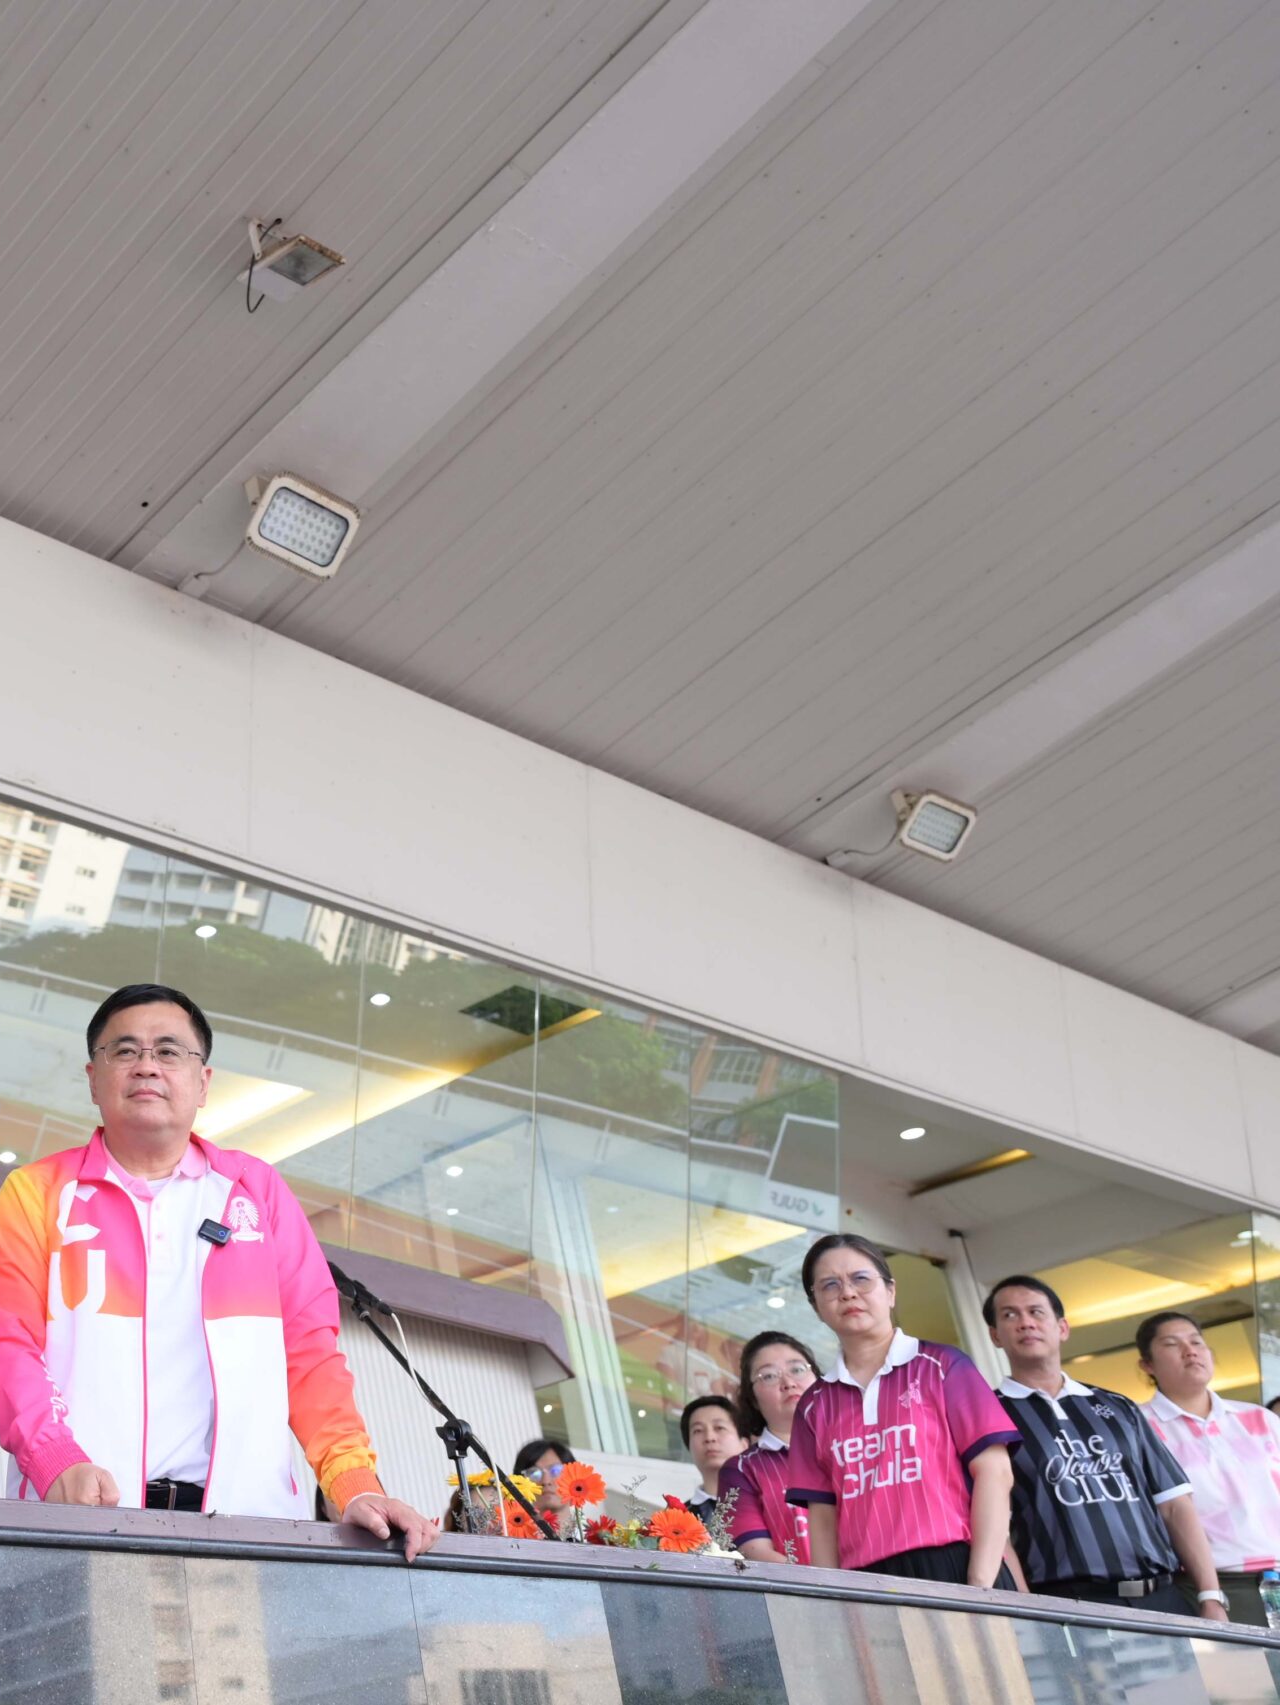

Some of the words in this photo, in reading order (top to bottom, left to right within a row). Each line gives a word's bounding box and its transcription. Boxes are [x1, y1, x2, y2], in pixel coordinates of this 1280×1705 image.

[830, 1423, 917, 1468] team
[1054, 1429, 1108, 1458] the
[842, 1450, 922, 1500] chula
